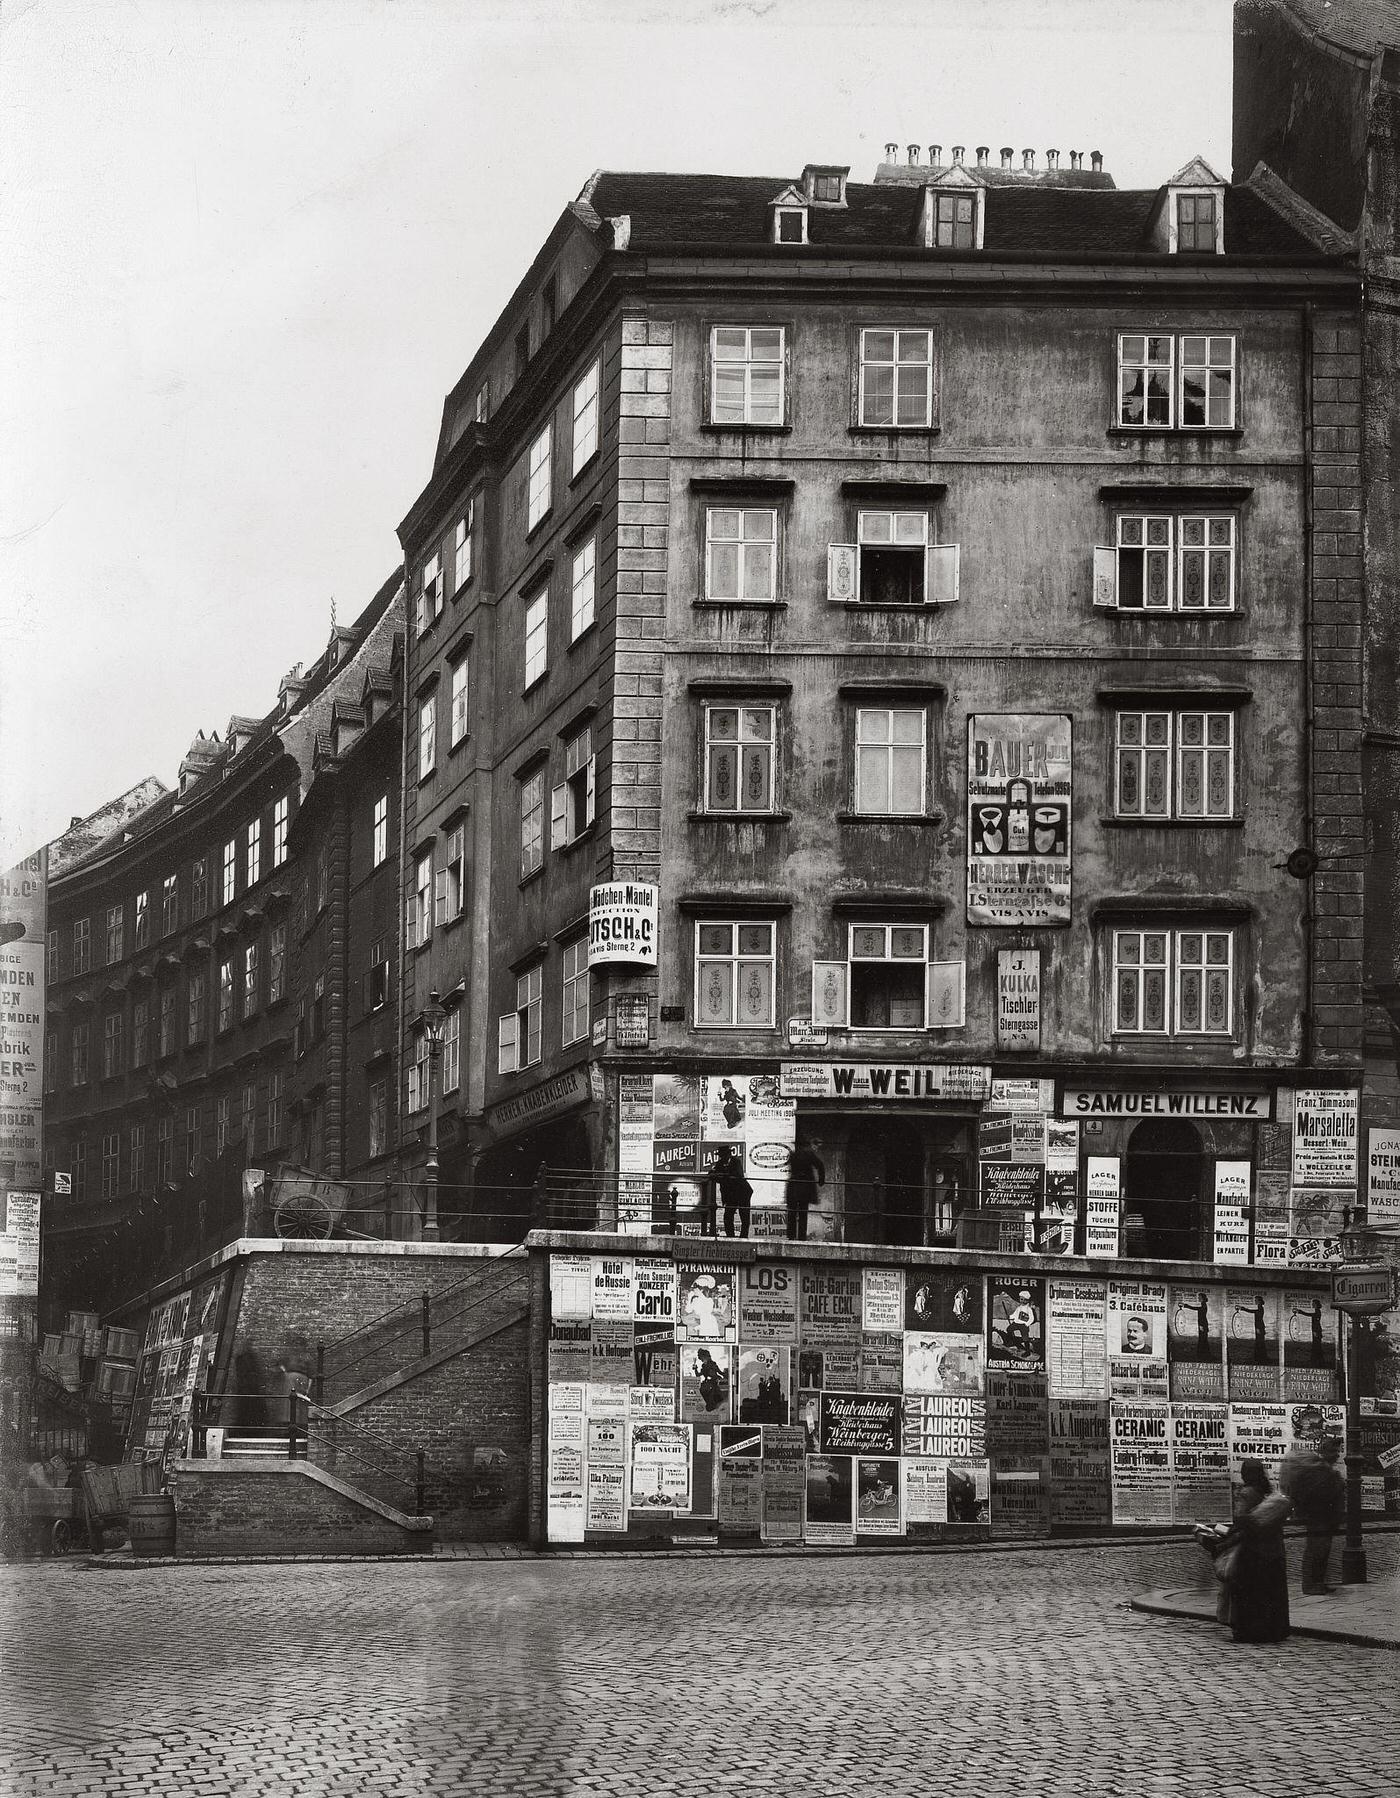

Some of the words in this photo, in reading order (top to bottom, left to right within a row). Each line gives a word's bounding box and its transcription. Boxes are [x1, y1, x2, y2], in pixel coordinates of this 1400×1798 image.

[869, 1069, 941, 1096] WEIL
[1075, 1093, 1165, 1113] SAMUEL
[1167, 1095, 1259, 1114] WILLENZ
[1296, 1097, 1317, 1108] Franz
[1091, 1172, 1117, 1181] LAGER
[1220, 1176, 1246, 1184] LAGER
[1088, 1201, 1118, 1213] STOFFE
[1256, 1244, 1286, 1258] Flora
[595, 1275, 604, 1287] de
[605, 1275, 631, 1289] Russie
[638, 1281, 670, 1290] KONZERT
[1336, 1278, 1387, 1299] Cigarren
[1109, 1282, 1140, 1297] Original
[1142, 1283, 1166, 1299] Brady
[636, 1290, 672, 1316] Carlo
[1109, 1300, 1119, 1311] 3.
[826, 1398, 895, 1417] Knabenkleider
[920, 1397, 973, 1417] LAUREOL
[828, 1426, 892, 1442] Weinberger
[920, 1416, 973, 1437] LAUREOL
[920, 1436, 973, 1457] LAUREOL
[1232, 1442, 1287, 1455] KONZERT
